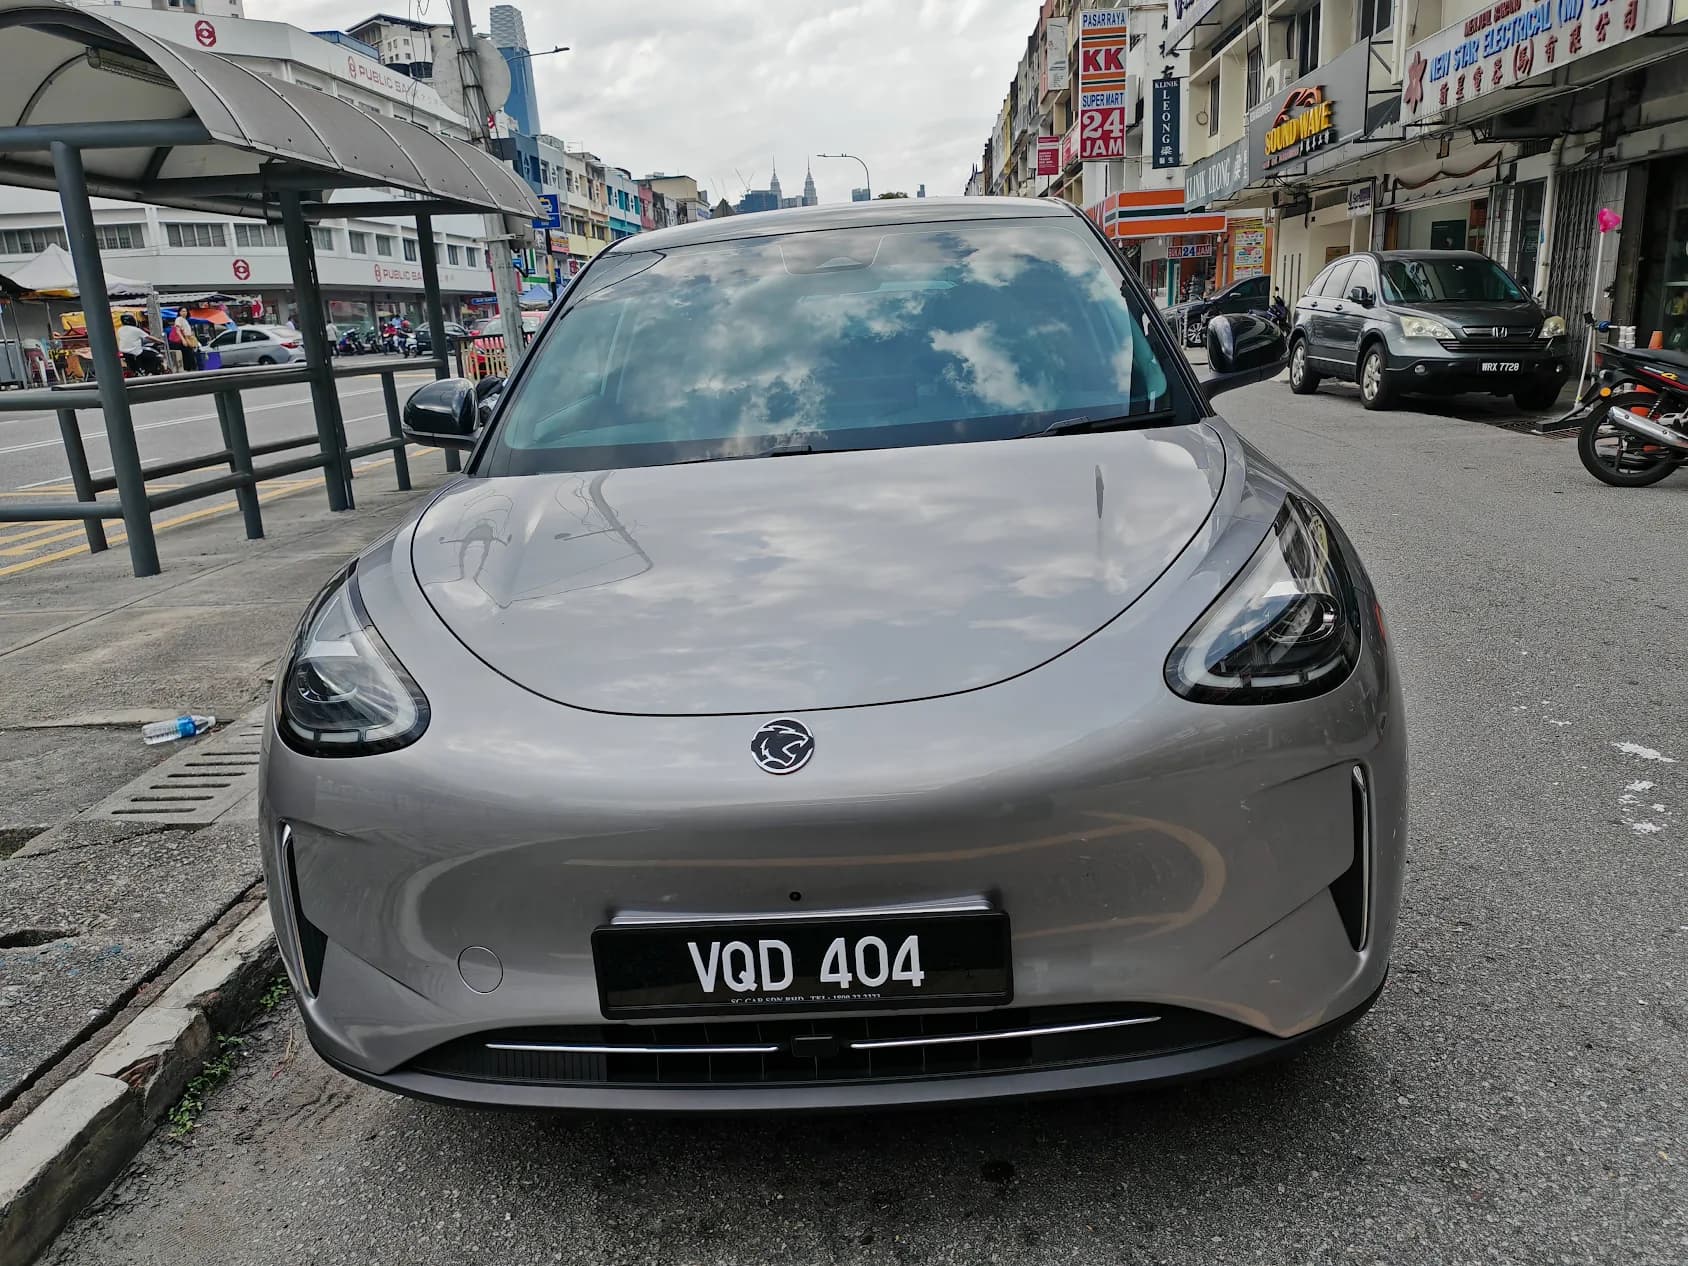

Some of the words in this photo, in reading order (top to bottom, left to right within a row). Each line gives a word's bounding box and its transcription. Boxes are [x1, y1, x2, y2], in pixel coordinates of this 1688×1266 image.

[1430, 49, 1451, 82] NEW
[1454, 38, 1479, 71] STAR
[1483, 2, 1552, 58] ELECTRICAL
[1083, 47, 1124, 72] KK
[358, 64, 393, 88] PUBLIC
[1083, 110, 1123, 139] 24
[1162, 90, 1171, 144] LEONG
[1265, 118, 1300, 156] SOUND
[1300, 100, 1333, 140] WAVE
[1083, 139, 1123, 157] JAM
[1185, 170, 1206, 203] KLINIK
[1208, 157, 1230, 194] LEONG
[1183, 246, 1196, 257] 24
[383, 269, 411, 281] PUBLIC
[1481, 362, 1497, 372] WRX
[687, 939, 794, 993] VQD
[820, 935, 925, 990] 404
